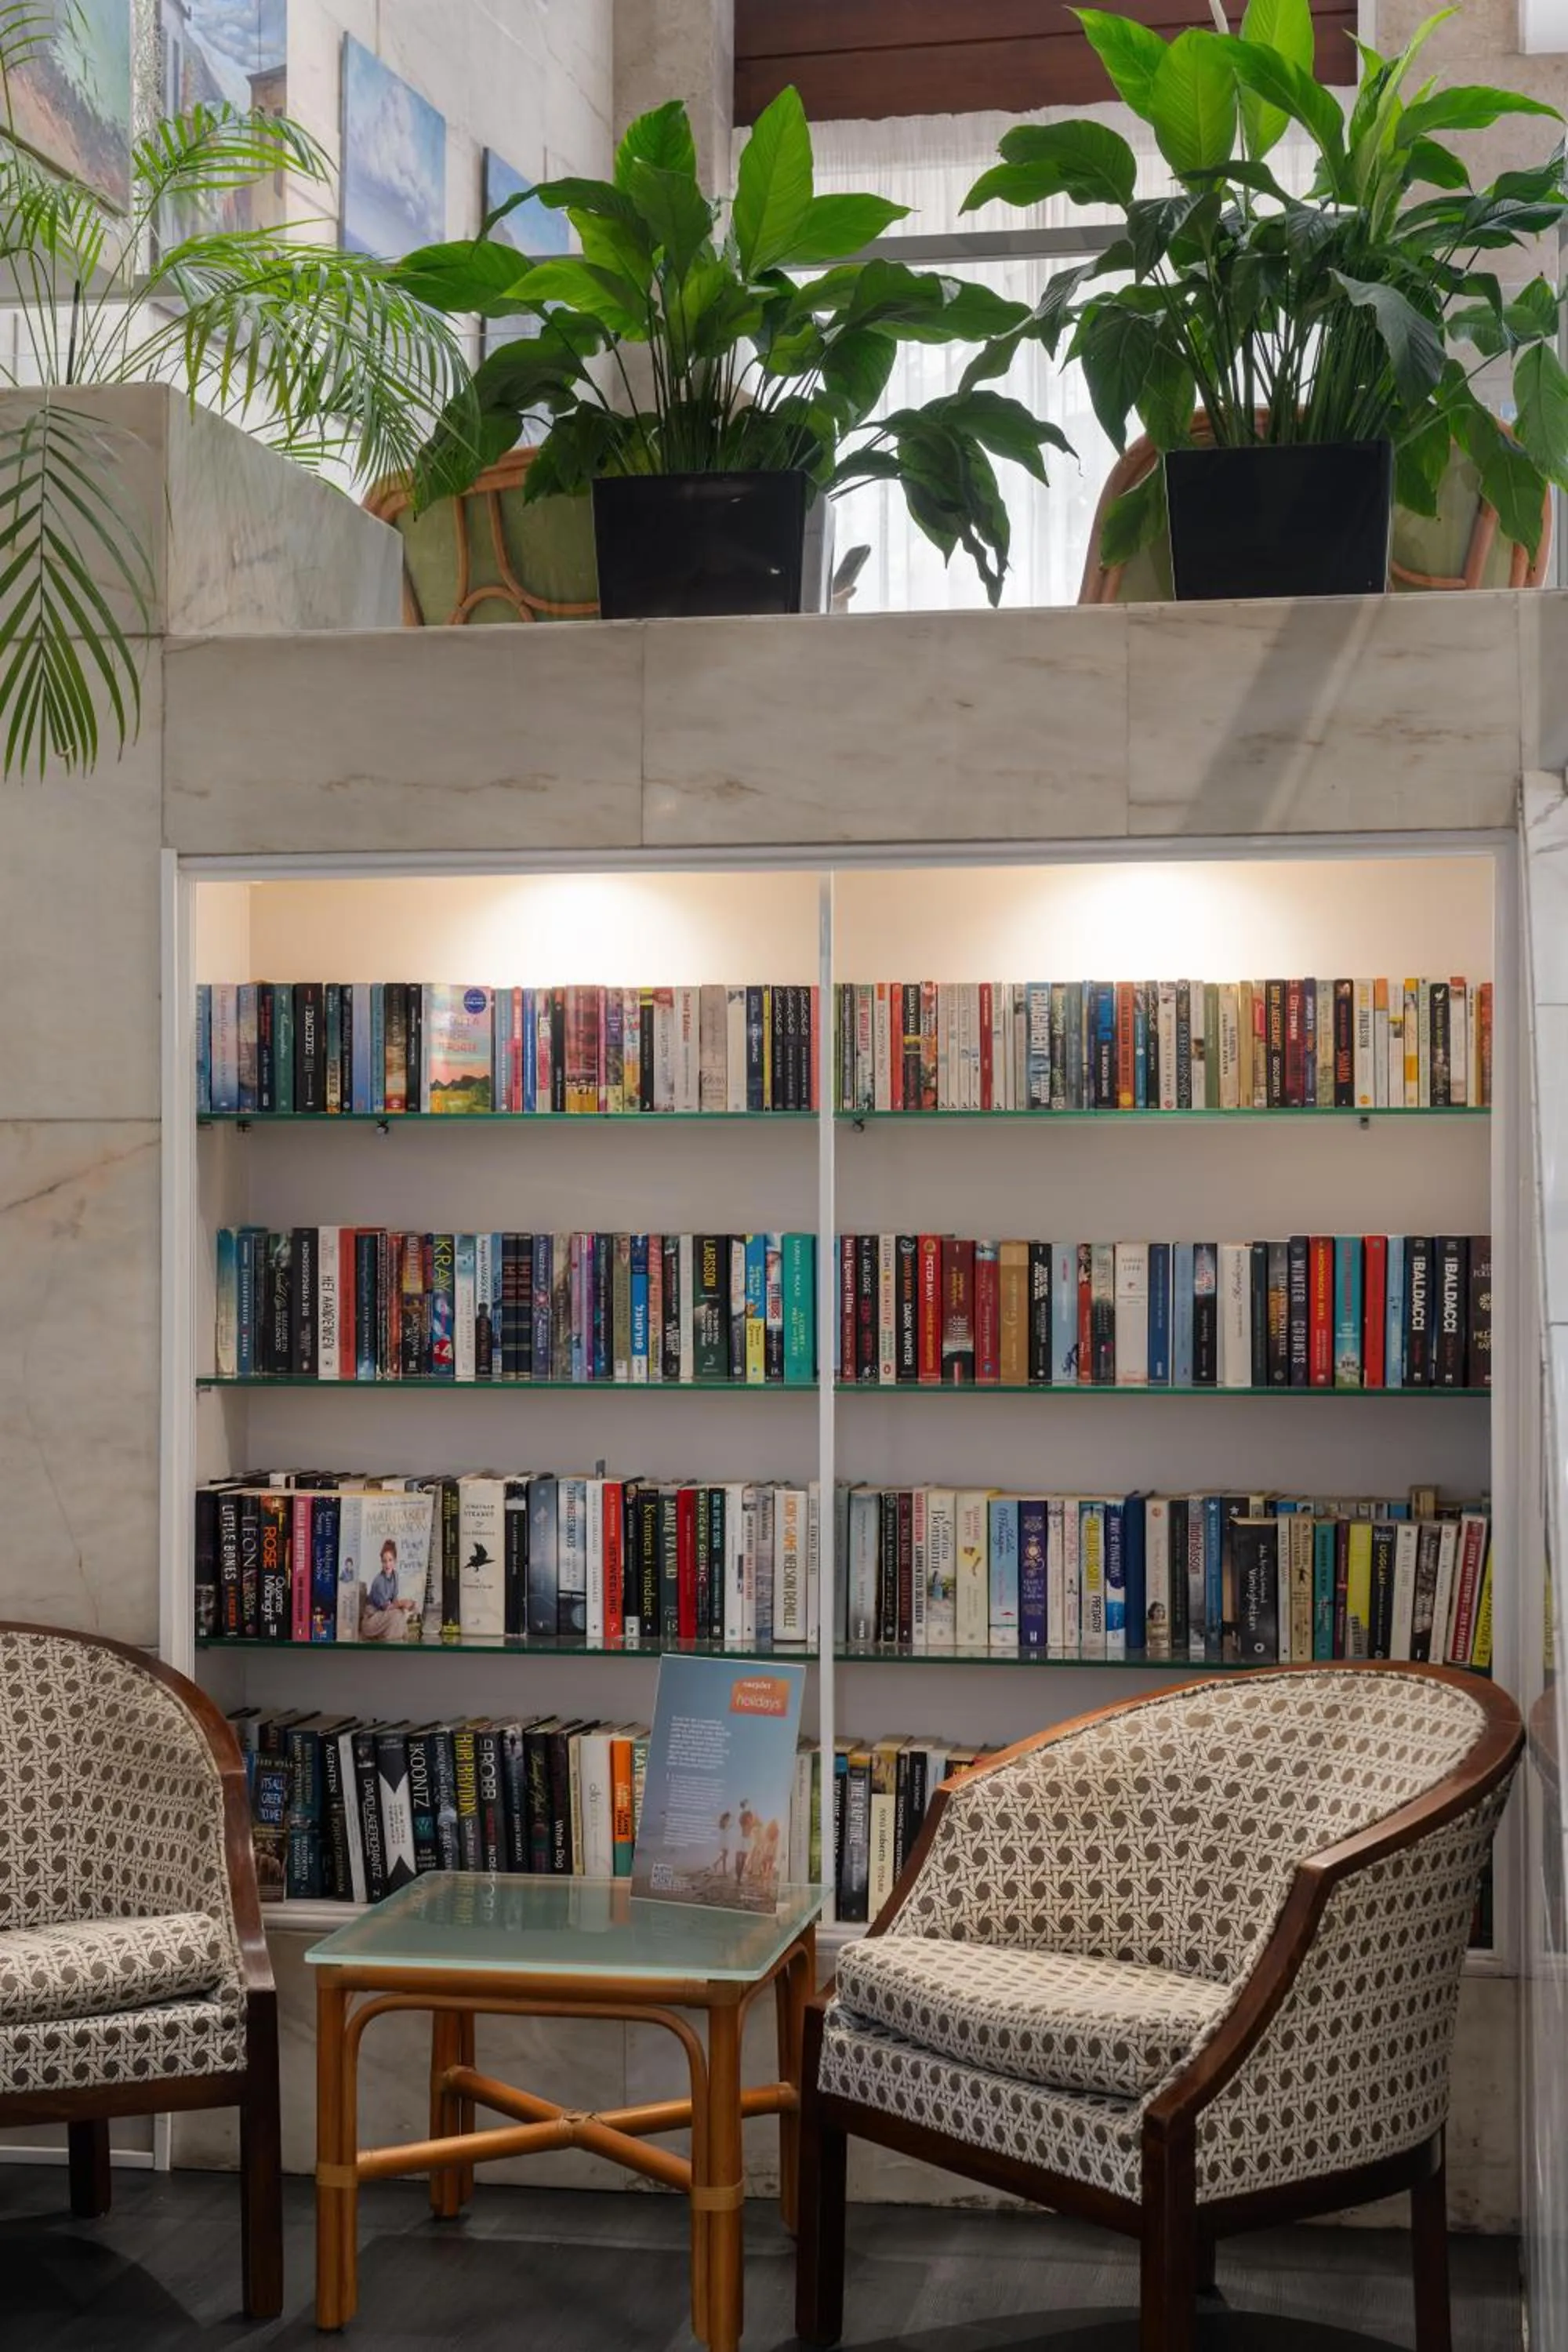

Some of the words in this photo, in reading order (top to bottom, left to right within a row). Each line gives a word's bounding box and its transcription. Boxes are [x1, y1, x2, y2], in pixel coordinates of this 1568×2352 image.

[1030, 989, 1048, 1055] FRAGMENT
[434, 1240, 452, 1292] KRAY
[703, 1240, 716, 1287] LARSSON
[845, 1240, 854, 1257] Just
[322, 1275, 335, 1292] HET
[843, 1260, 854, 1290] Ignore
[1291, 1260, 1306, 1302] WINTER
[845, 1293, 854, 1314] Him
[884, 1283, 892, 1326] CHEMISTRY
[903, 1302, 912, 1328] DARK
[1412, 1261, 1426, 1330] BALDACCI
[1443, 1263, 1458, 1333] BALDACCI
[322, 1296, 335, 1350] AANDENKEN
[1291, 1319, 1306, 1364] COUNTS
[903, 1330, 912, 1366] WINTER
[221, 1504, 236, 1541] LITTLE
[643, 1503, 655, 1556] Kvinnen
[698, 1492, 706, 1539] MEXICAN
[263, 1526, 277, 1569] ROSE
[296, 1529, 307, 1572] BEAUTIFUL
[663, 1536, 677, 1549] ZA
[931, 1510, 945, 1570] Bomann
[941, 1520, 953, 1560] Corina
[221, 1544, 236, 1581] BONES
[663, 1552, 677, 1579] CENA
[698, 1543, 706, 1583] GOTHIC
[785, 1554, 797, 1589] NELSON
[1377, 1544, 1387, 1585] UGGLAN
[261, 1574, 275, 1622] Midnight
[274, 1576, 285, 1615] Quarter
[643, 1569, 655, 1617] vinduet
[785, 1592, 797, 1628] DEMILLE
[1091, 1595, 1102, 1634] PREDATOR
[737, 1693, 782, 1711] holidays
[292, 1734, 302, 1761] JAMES
[455, 1733, 474, 1760] ROB
[293, 1763, 302, 1811] PATTERSON
[325, 1744, 338, 1793] AGENTEN
[410, 1748, 430, 1809] KOONTZ
[478, 1752, 497, 1800] ROBB
[362, 1778, 374, 1806] DAVID
[456, 1762, 477, 1817] BRYDON
[849, 1780, 865, 1798] THE
[330, 1817, 339, 1842] JOHN
[367, 1806, 382, 1878] LAGERCRANTZ
[555, 1819, 564, 1846] White
[849, 1801, 865, 1845] RAPTURE
[334, 1845, 345, 1892] GRISHAM
[487, 1844, 496, 1856] IN
[554, 1849, 564, 1868] Dog
